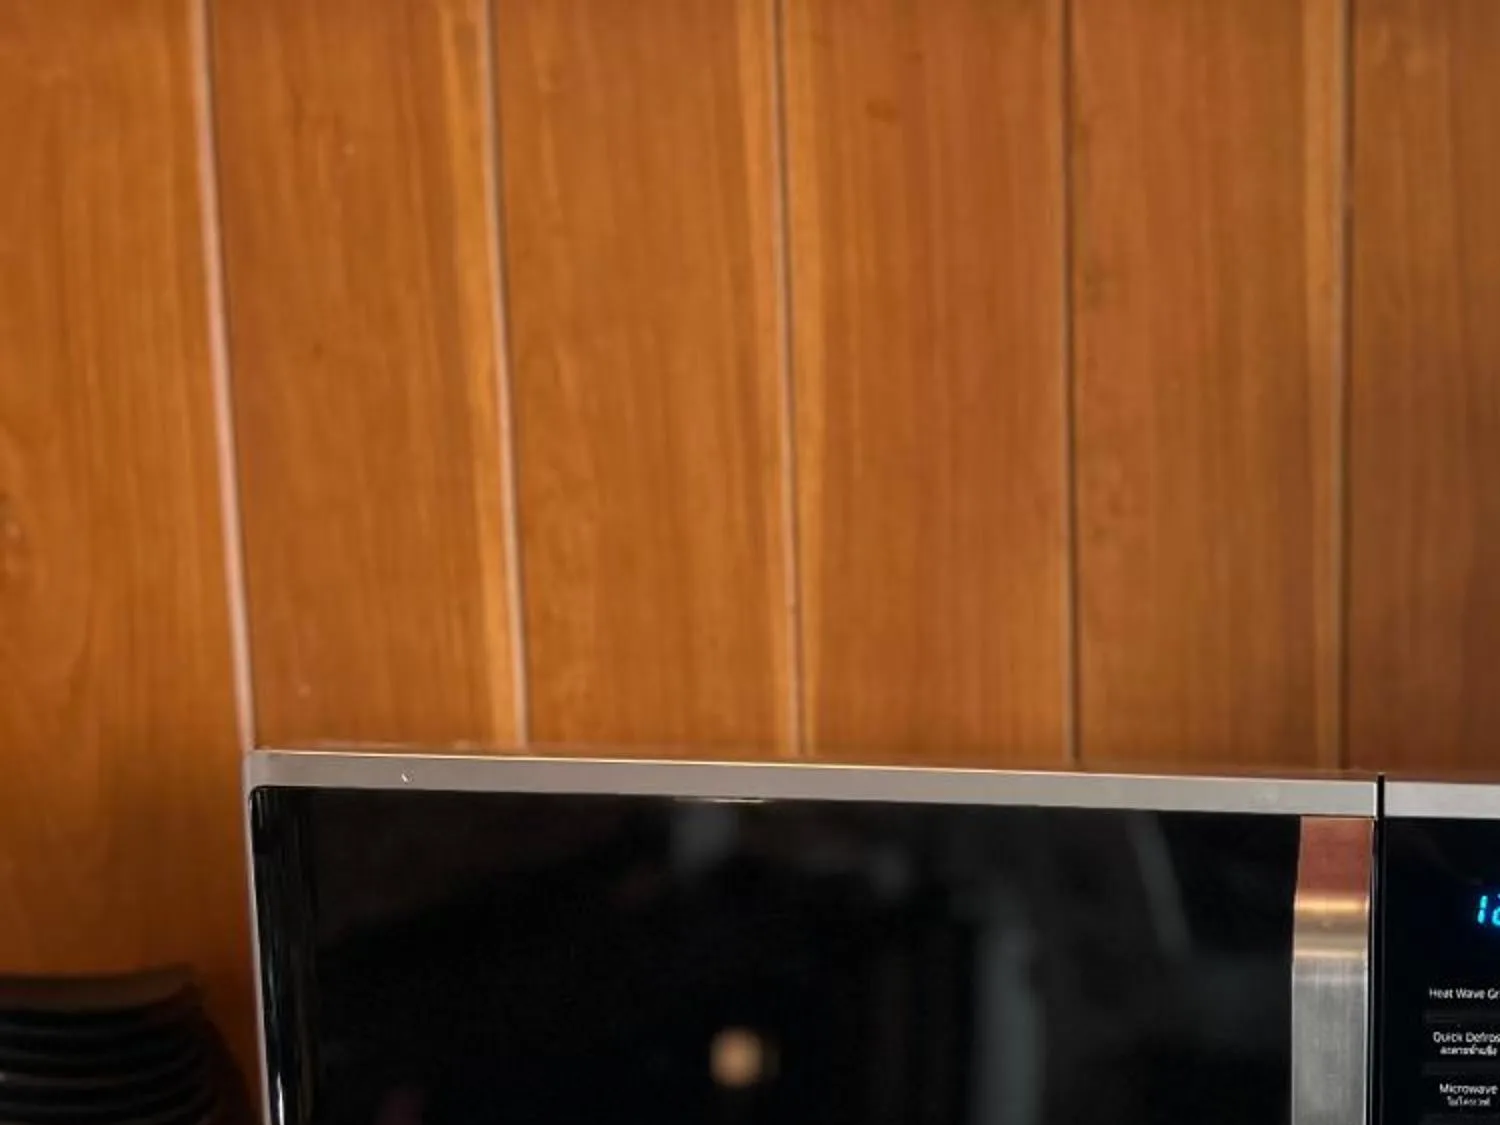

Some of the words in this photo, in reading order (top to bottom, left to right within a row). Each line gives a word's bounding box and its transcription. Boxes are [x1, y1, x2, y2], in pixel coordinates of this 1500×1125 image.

[1429, 987, 1452, 999] Heat
[1455, 987, 1484, 999] Wave
[1433, 1031, 1463, 1043] Quick
[1439, 1083, 1498, 1095] Microwave
